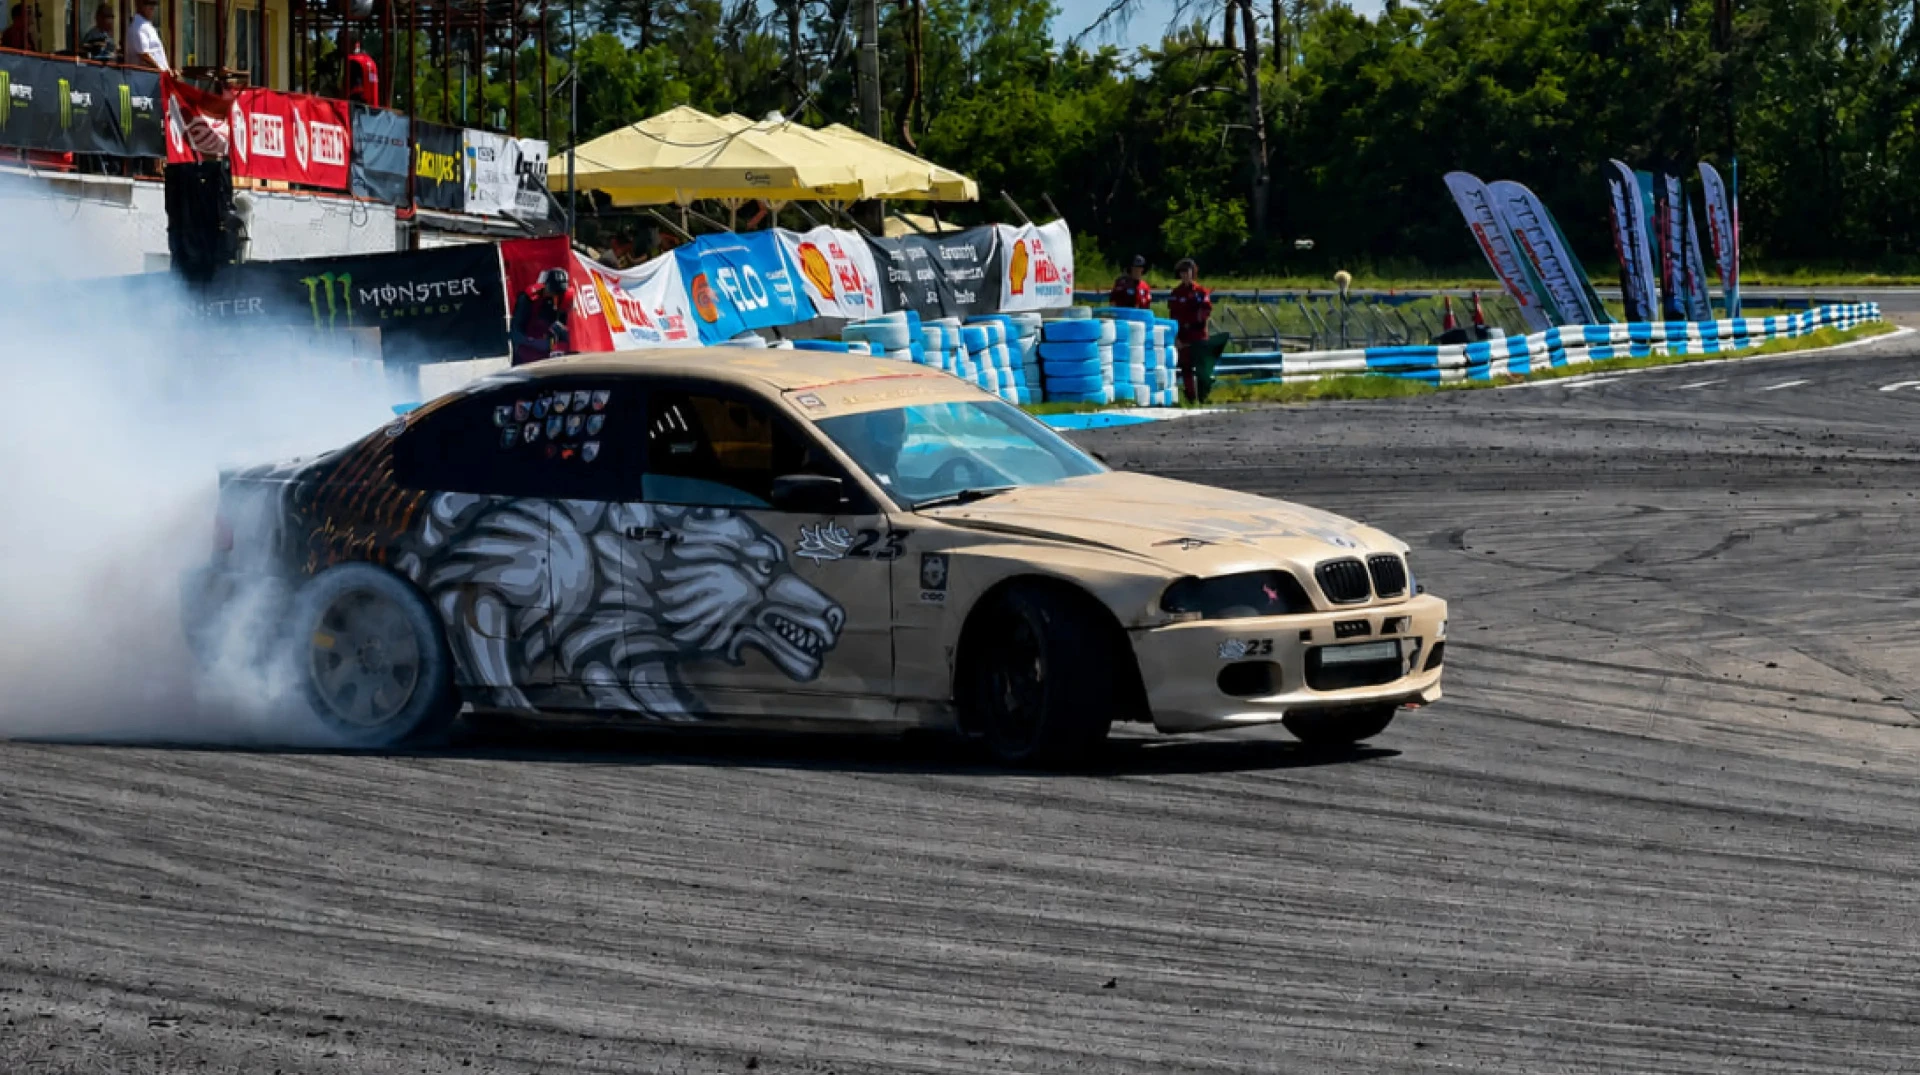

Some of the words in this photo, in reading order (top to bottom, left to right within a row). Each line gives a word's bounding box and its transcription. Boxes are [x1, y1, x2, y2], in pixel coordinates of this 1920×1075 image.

[359, 277, 480, 306] MONSTER
[848, 529, 914, 560] 23
[1245, 638, 1273, 656] 23
